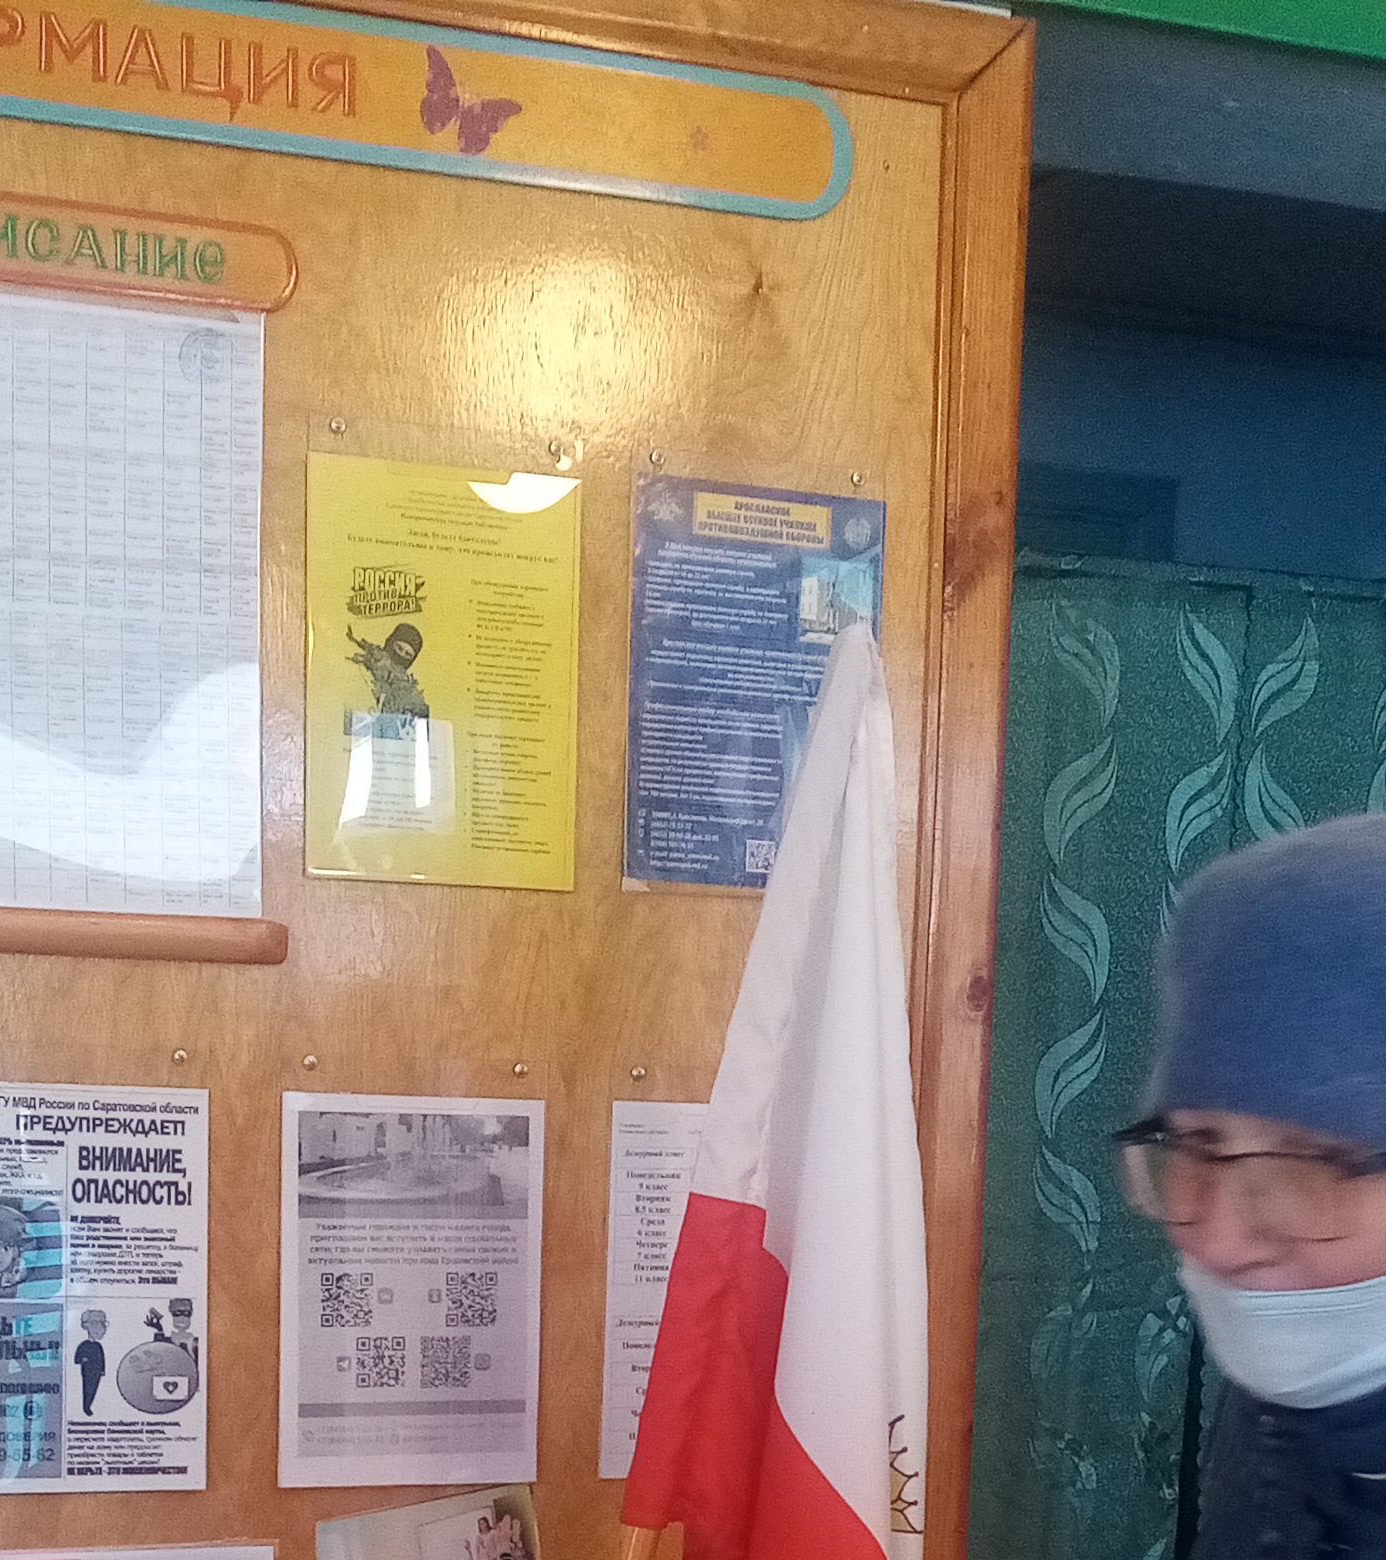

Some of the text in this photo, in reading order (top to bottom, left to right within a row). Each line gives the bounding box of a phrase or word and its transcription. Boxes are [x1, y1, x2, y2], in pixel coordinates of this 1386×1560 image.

[353, 567, 416, 597] РОССИЯ
[13, 1097, 36, 1110] МВД
[39, 1098, 75, 1110] России
[78, 1102, 90, 1112] по
[93, 1100, 156, 1114] Саратовской
[160, 1103, 198, 1115] области
[16, 1115, 185, 1138] ПРЕДУПРЕЖДАЕТ!
[79, 1146, 186, 1177] ВНИМАНИЕ,
[72, 1178, 192, 1206] ОПАСНОСТЬ!
